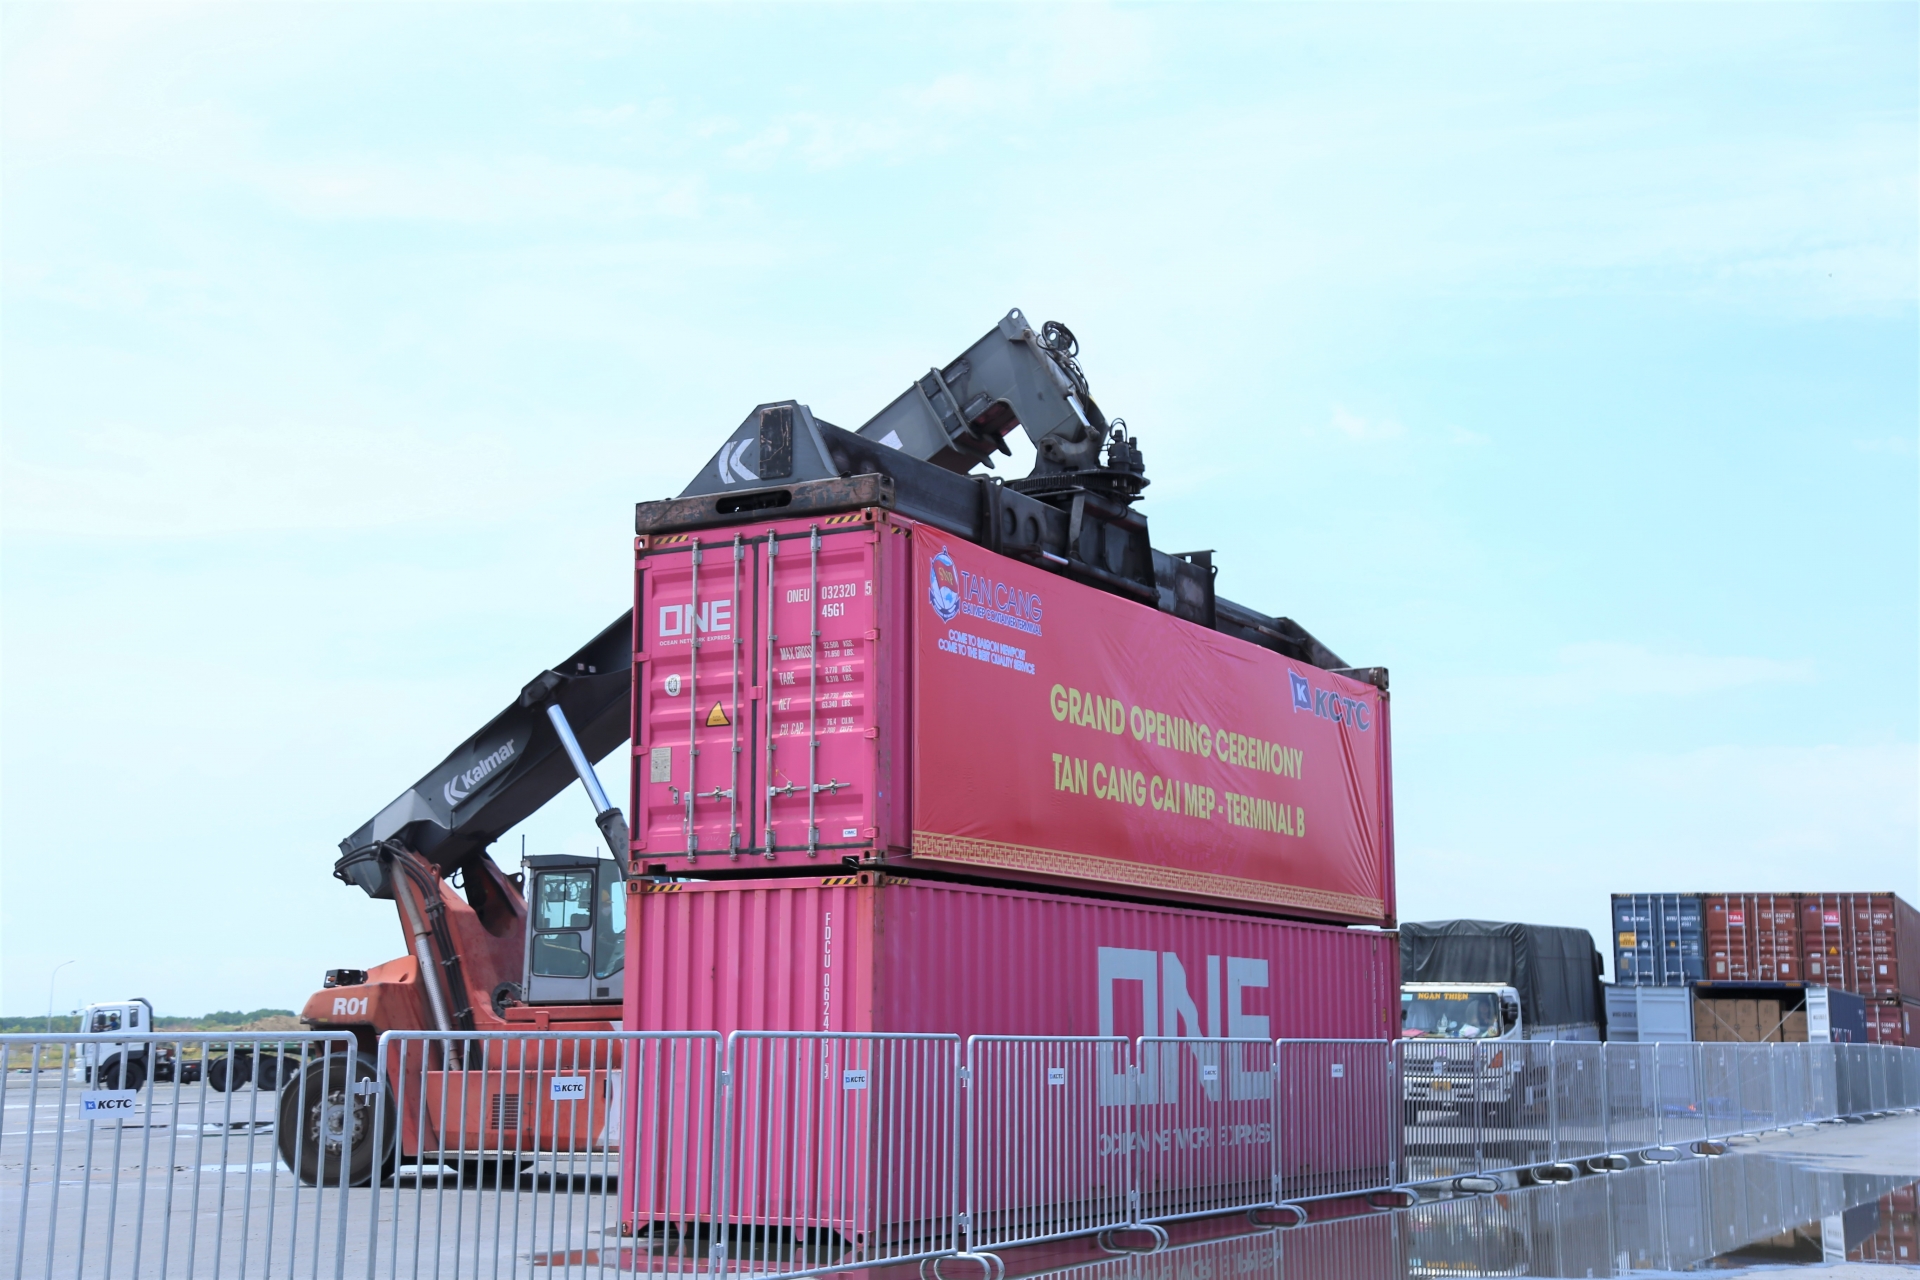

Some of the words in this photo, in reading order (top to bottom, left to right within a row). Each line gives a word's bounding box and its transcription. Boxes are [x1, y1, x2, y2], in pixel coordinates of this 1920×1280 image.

[787, 588, 810, 603] ONEU
[821, 583, 856, 600] 032320
[865, 581, 872, 595] 5
[961, 571, 992, 607] TAN
[995, 582, 1042, 622] CANG
[659, 599, 731, 637] ONE
[821, 602, 844, 618] 45G1
[962, 601, 973, 615] CAI
[974, 604, 986, 618] MEP
[986, 609, 1017, 628] CONTAINER
[1016, 618, 1042, 636] TERMINAL
[707, 634, 731, 642] EXPRESS
[948, 629, 967, 641] COME
[968, 634, 977, 646] TO
[977, 637, 999, 653] SAIGON
[1000, 643, 1026, 660] NEWPORT
[938, 638, 958, 653] COME
[958, 644, 967, 655] TO
[967, 646, 977, 660] THE
[978, 649, 990, 662] BEST
[991, 652, 1013, 669] QUALITY
[1014, 659, 1035, 675] SERVICE
[779, 672, 795, 685] TARE
[1314, 687, 1370, 732] KCTC
[1050, 683, 1125, 735] GRAND
[1130, 705, 1212, 758] OPENING
[1215, 729, 1303, 780] CEREMONY
[460, 738, 515, 790] Kalmar
[1052, 752, 1088, 796] TAN
[1092, 762, 1147, 807] CANG
[1150, 775, 1180, 814] CAI
[1184, 782, 1216, 820] MEP
[1225, 792, 1295, 836] TERMINAL
[1296, 806, 1306, 838] B
[332, 997, 368, 1015] R01
[1098, 946, 1271, 1106] ONE
[97, 1099, 132, 1109] KCTC
[561, 1084, 583, 1092] KCTC
